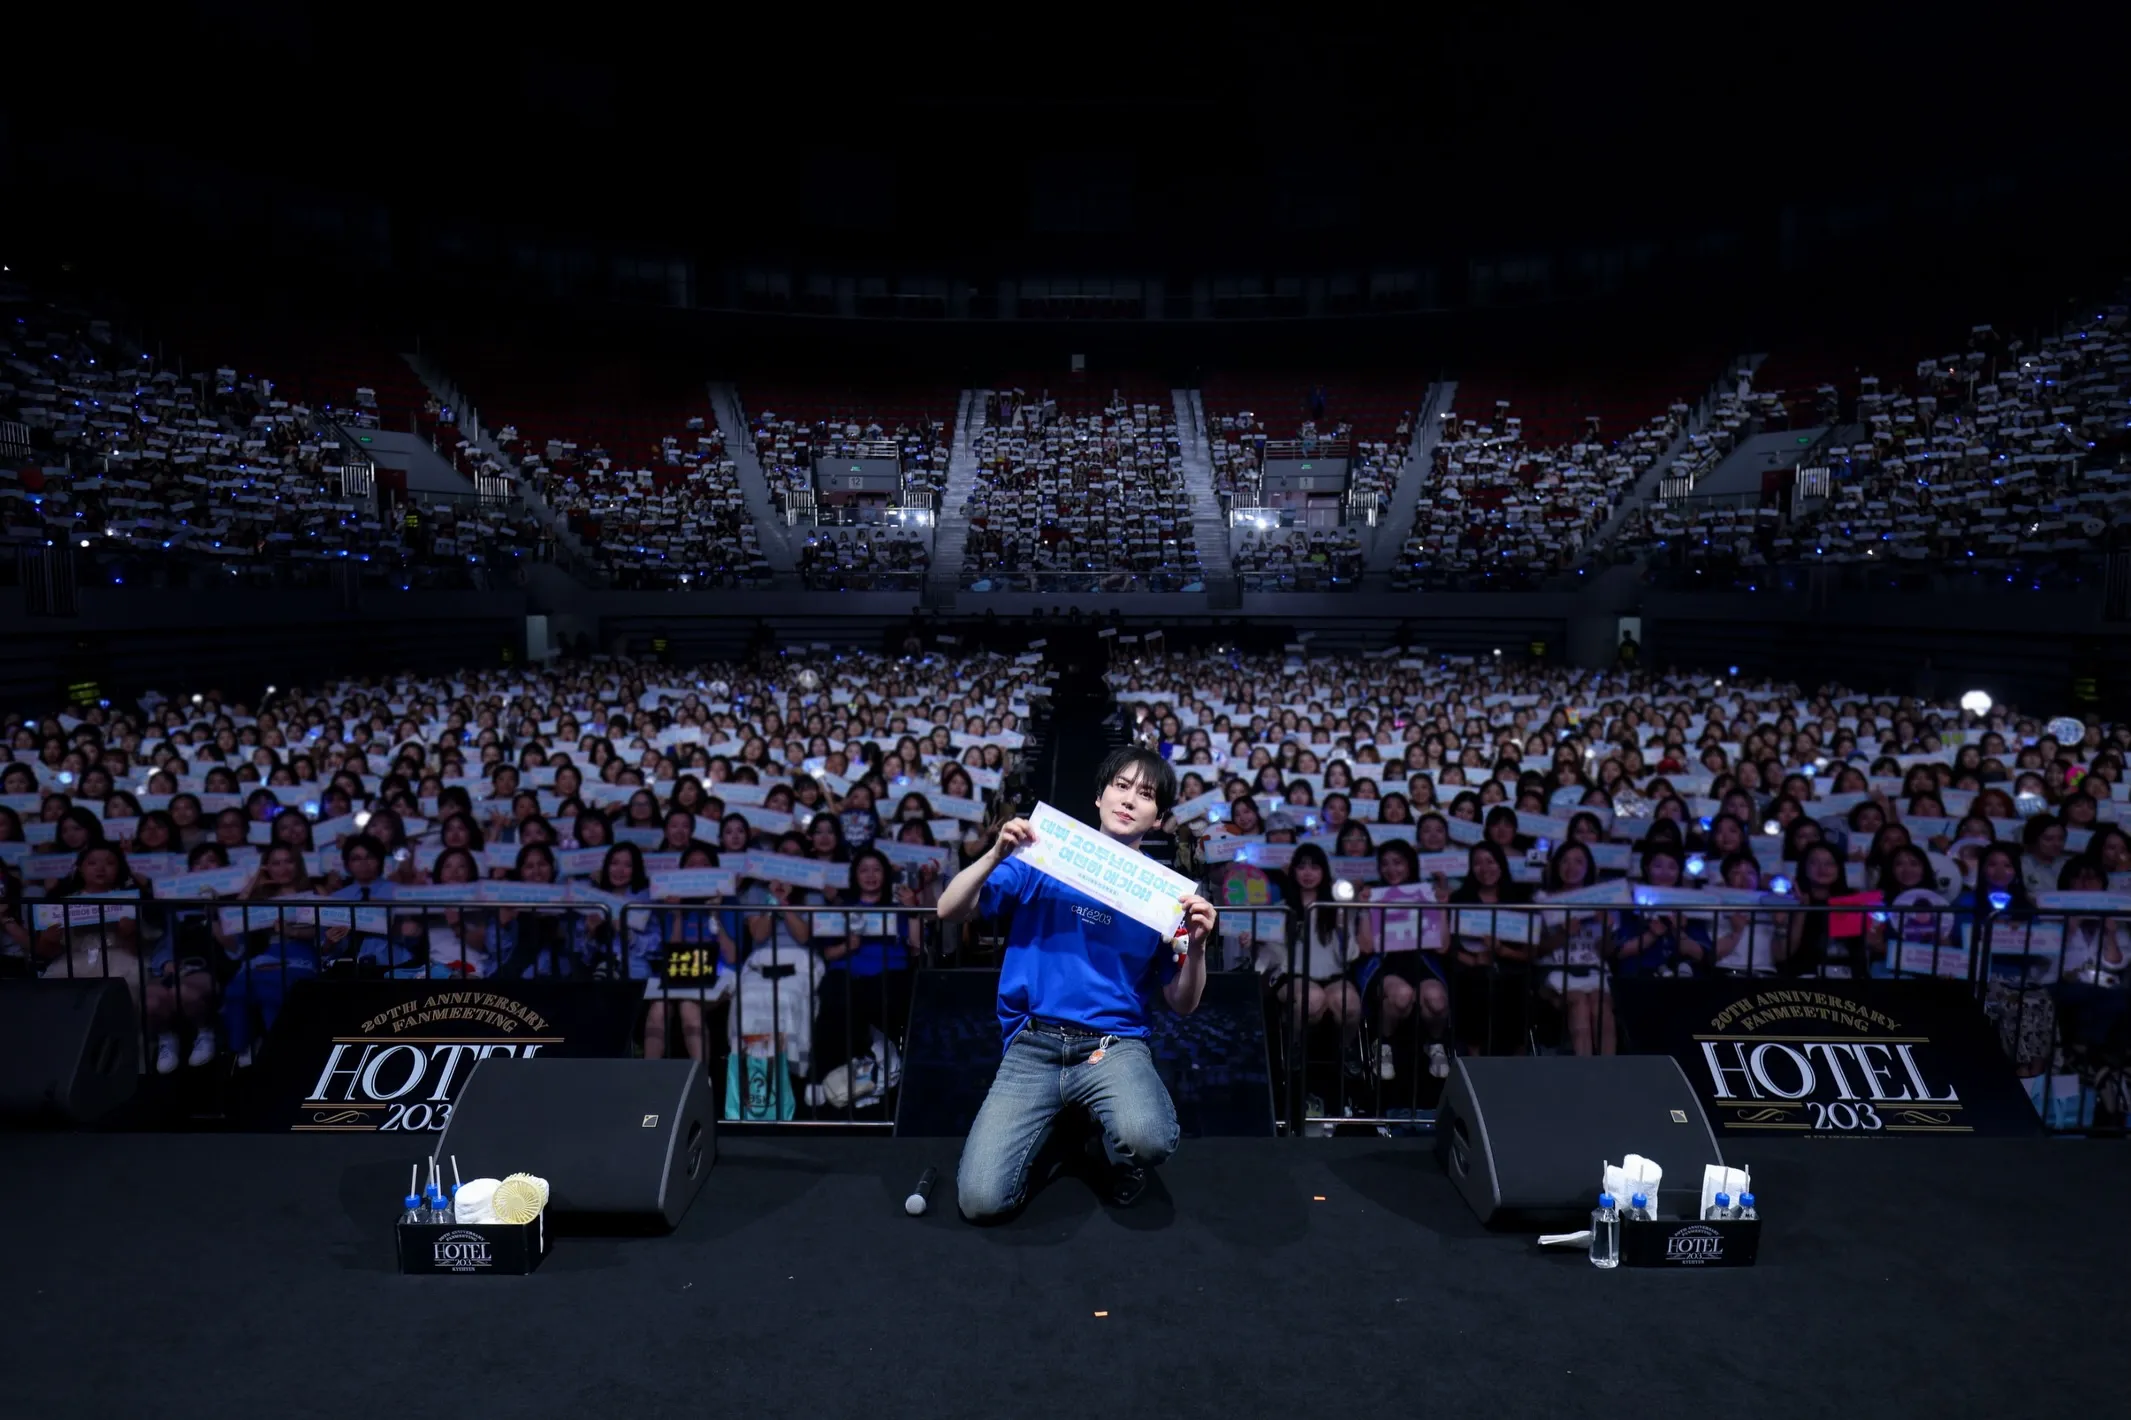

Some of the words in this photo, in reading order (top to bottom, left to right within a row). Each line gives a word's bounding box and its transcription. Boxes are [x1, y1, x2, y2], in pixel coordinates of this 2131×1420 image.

[851, 477, 861, 485] 12
[361, 1000, 418, 1033] 20TH
[423, 991, 550, 1032] ANNIVERSARY
[392, 1007, 519, 1033] FANMEETING
[1711, 997, 1755, 1032] 20TH
[1756, 990, 1902, 1032] ANNIVERSARY
[1740, 1005, 1869, 1032] FANMEETING
[304, 1044, 543, 1100] HOT
[1701, 1042, 1959, 1101] HOTEL
[379, 1103, 453, 1131] 203
[1806, 1102, 1883, 1130] 203
[434, 1244, 492, 1259] HOTEL
[1668, 1238, 1723, 1253] HOTEL
[1686, 1252, 1703, 1260] 203
